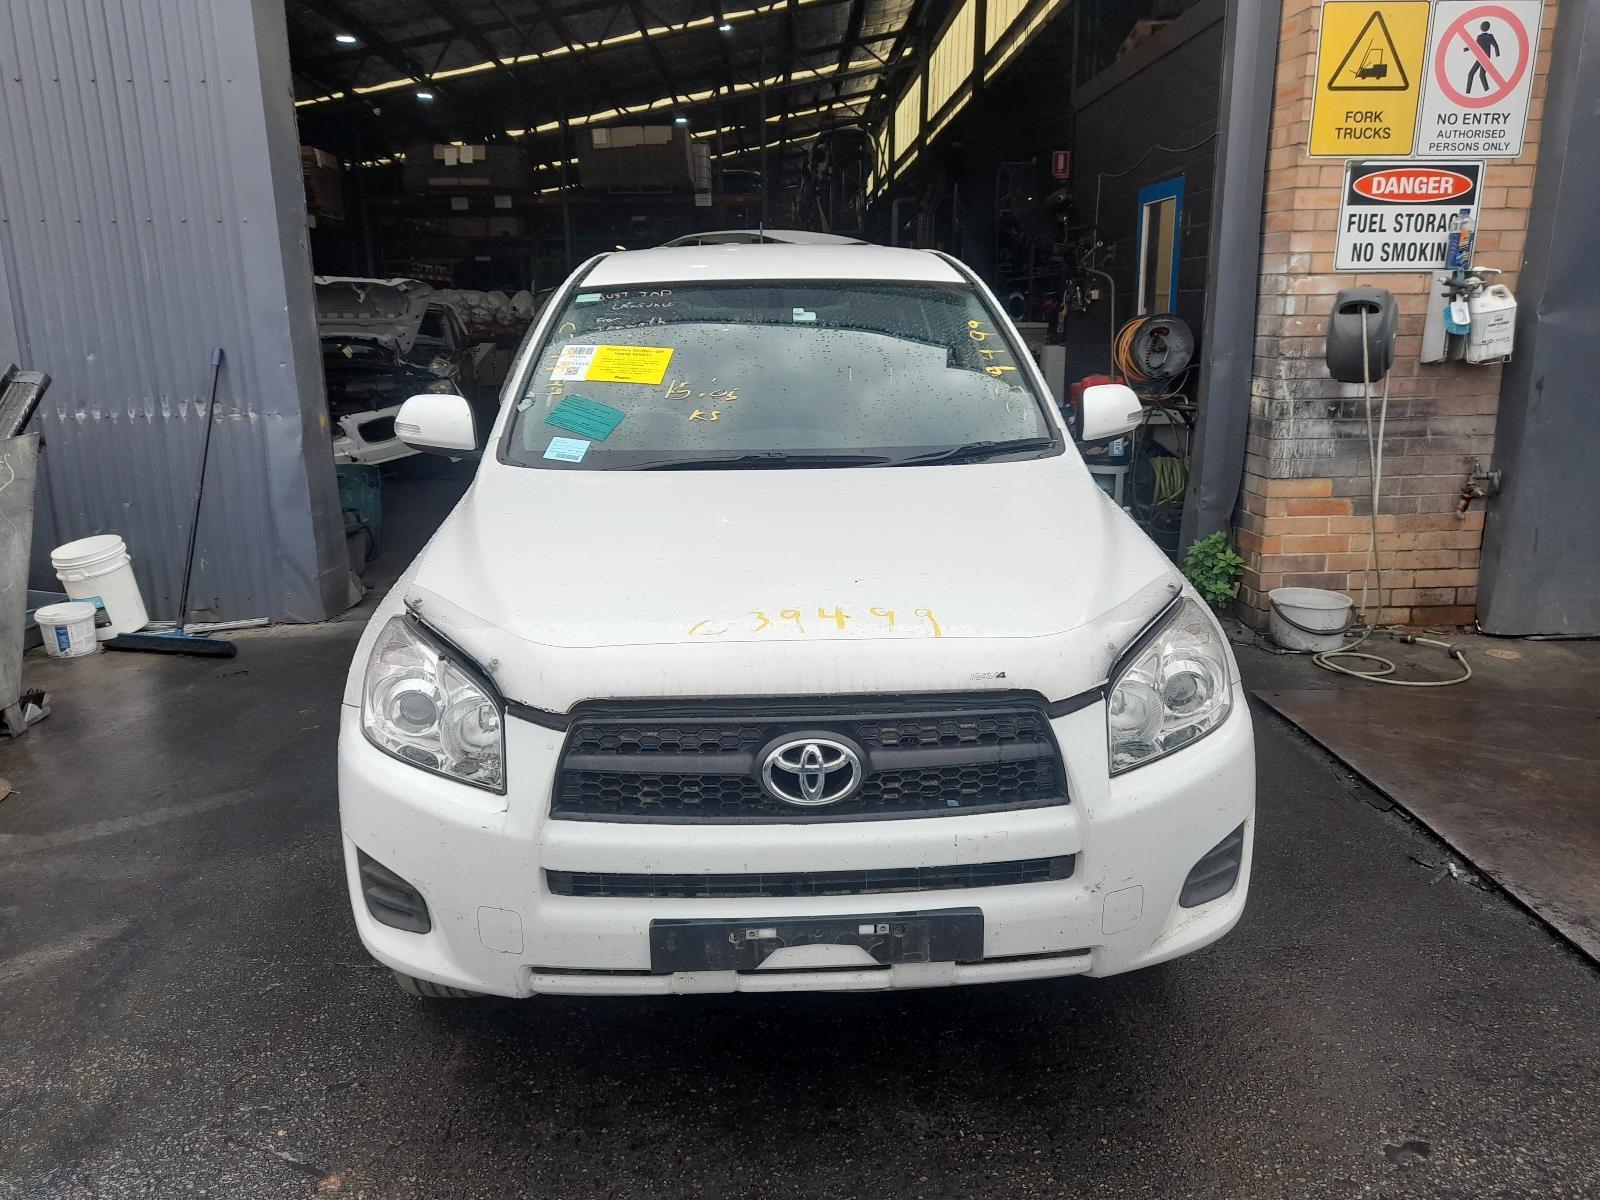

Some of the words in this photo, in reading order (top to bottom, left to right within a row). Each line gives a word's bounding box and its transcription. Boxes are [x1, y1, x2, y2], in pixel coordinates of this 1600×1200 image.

[1344, 111, 1384, 123] FORK
[1437, 113, 1458, 125] NO
[1462, 112, 1511, 125] ENTRY
[1335, 127, 1391, 139] TRUCKS
[1436, 129, 1506, 139] AUTHORISED
[1429, 142, 1480, 152] PERSONS
[1482, 142, 1511, 151] ONLY
[1371, 176, 1454, 195] DANGER
[1347, 212, 1387, 233] FUEL
[1351, 242, 1374, 262] NO
[1380, 242, 1448, 262] SMOKIN
